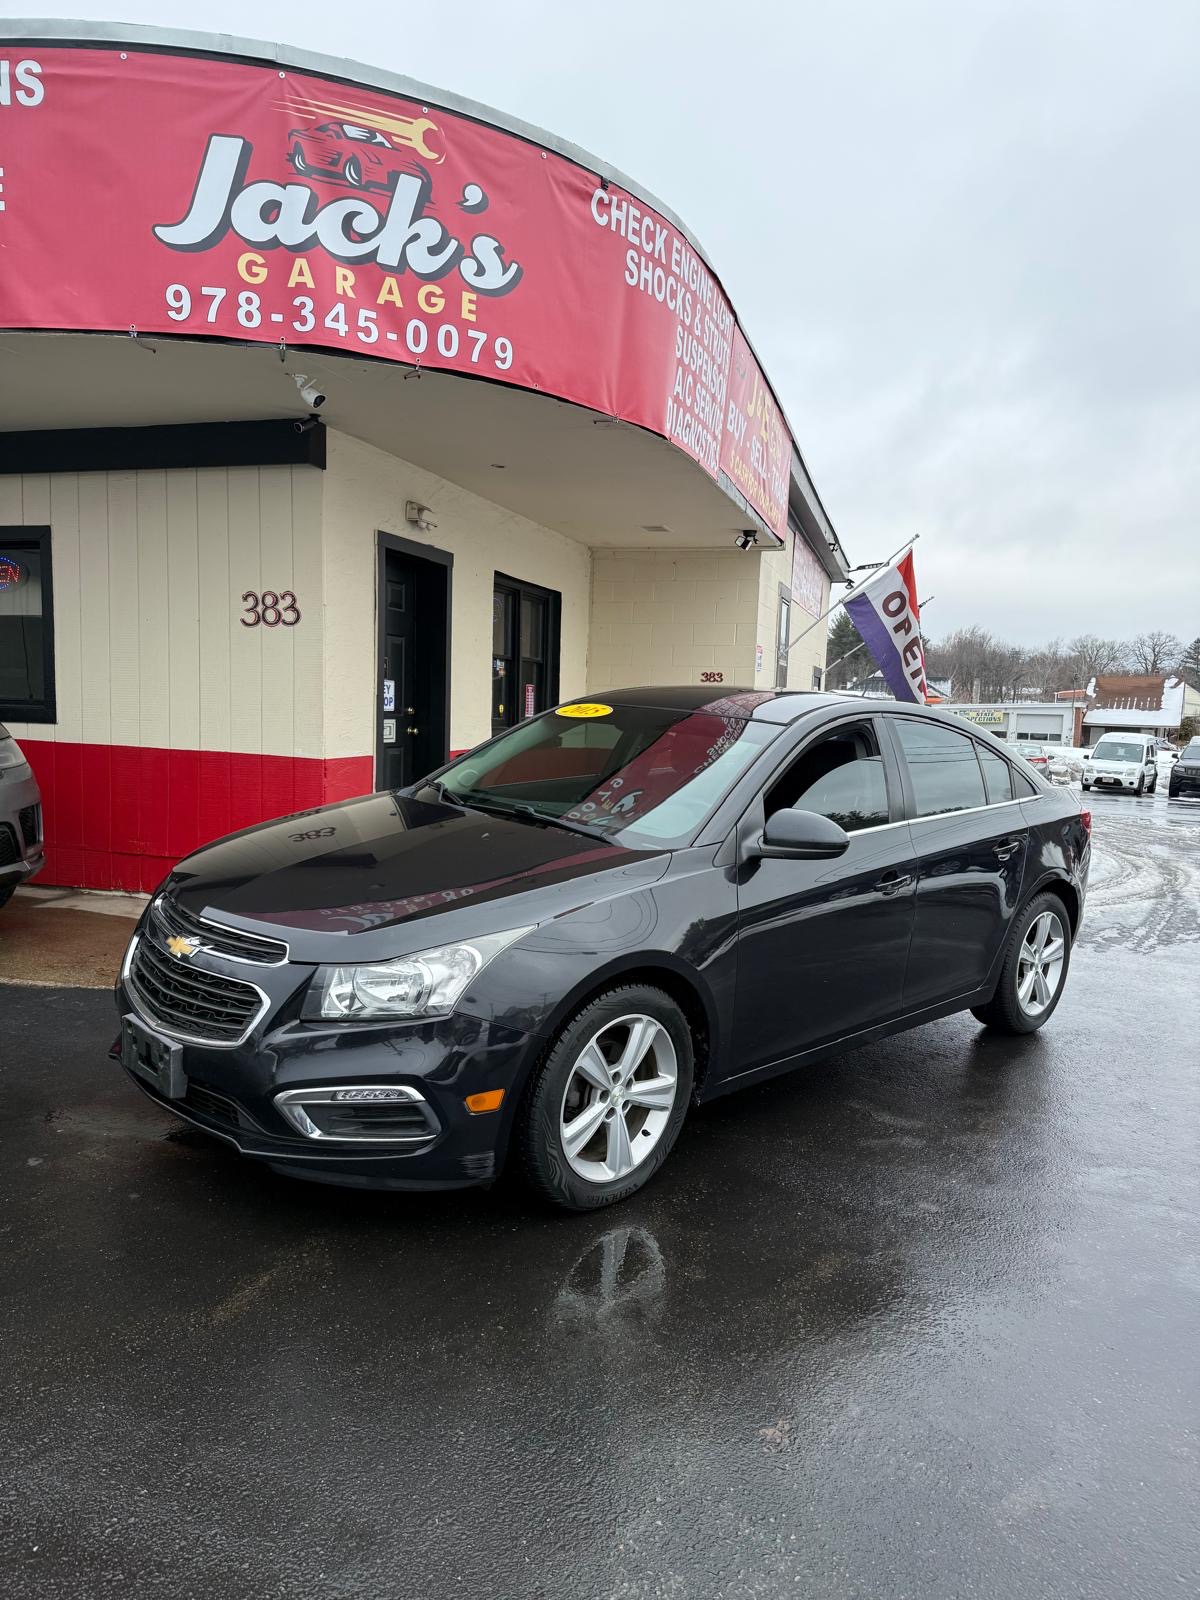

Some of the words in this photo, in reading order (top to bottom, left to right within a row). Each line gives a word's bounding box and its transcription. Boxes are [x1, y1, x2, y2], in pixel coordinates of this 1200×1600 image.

[153, 135, 522, 296] Jack's
[237, 253, 477, 322] GARAGE
[591, 188, 667, 265] CHECK
[672, 237, 712, 311] ENGINE
[713, 288, 734, 342] LIGHT
[165, 284, 514, 370] 978-345-0079
[625, 249, 691, 326] SHOCKS
[694, 304, 702, 337] &
[703, 315, 730, 375] STRUTS
[673, 366, 694, 407] A/C
[694, 383, 724, 440] SERVICE
[675, 325, 727, 407] SUSPENSION
[665, 397, 720, 474] DIAGNOSTICS
[727, 399, 747, 447] BUY
[751, 434, 768, 480] SELL
[240, 590, 301, 628] 383
[700, 671, 724, 683] 383
